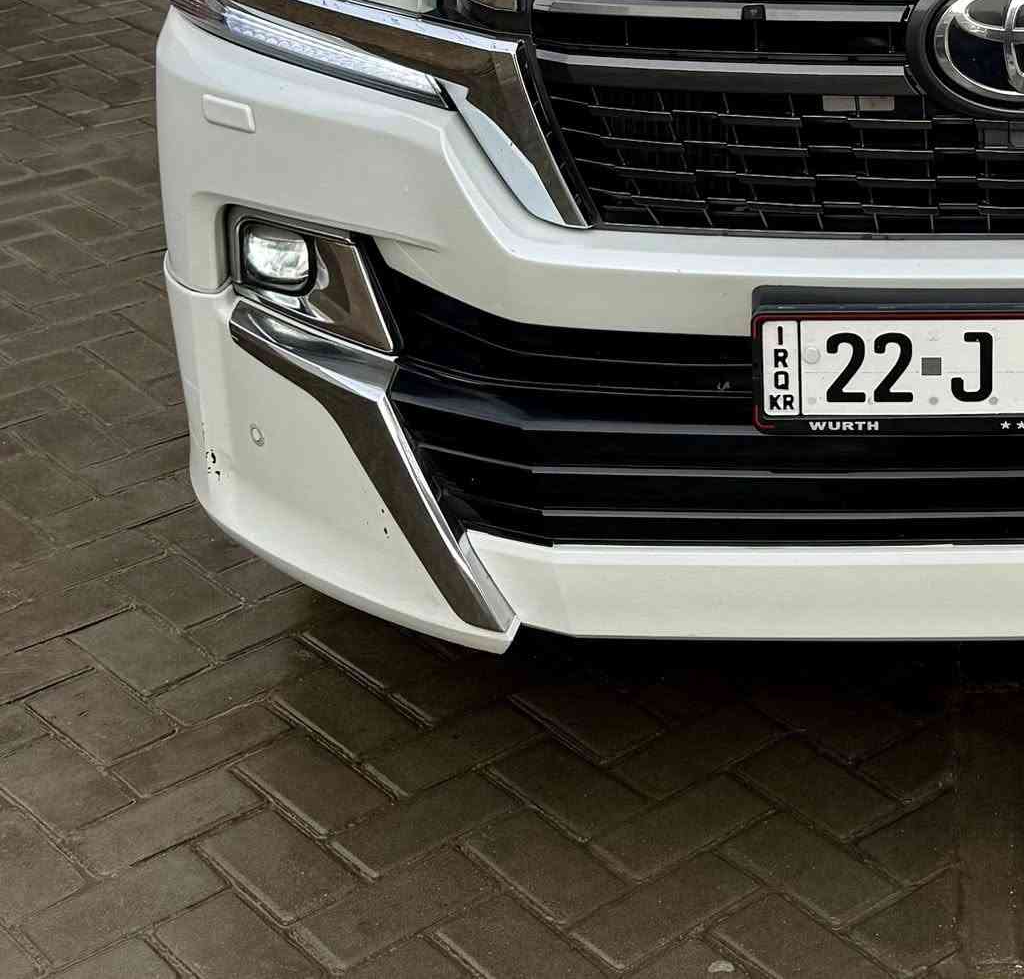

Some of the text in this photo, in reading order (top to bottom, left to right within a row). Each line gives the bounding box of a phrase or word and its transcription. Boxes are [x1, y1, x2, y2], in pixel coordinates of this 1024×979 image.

[826, 332, 914, 403] 22
[950, 331, 994, 403] J
[769, 394, 795, 411] KR
[808, 420, 879, 431] WURTH
